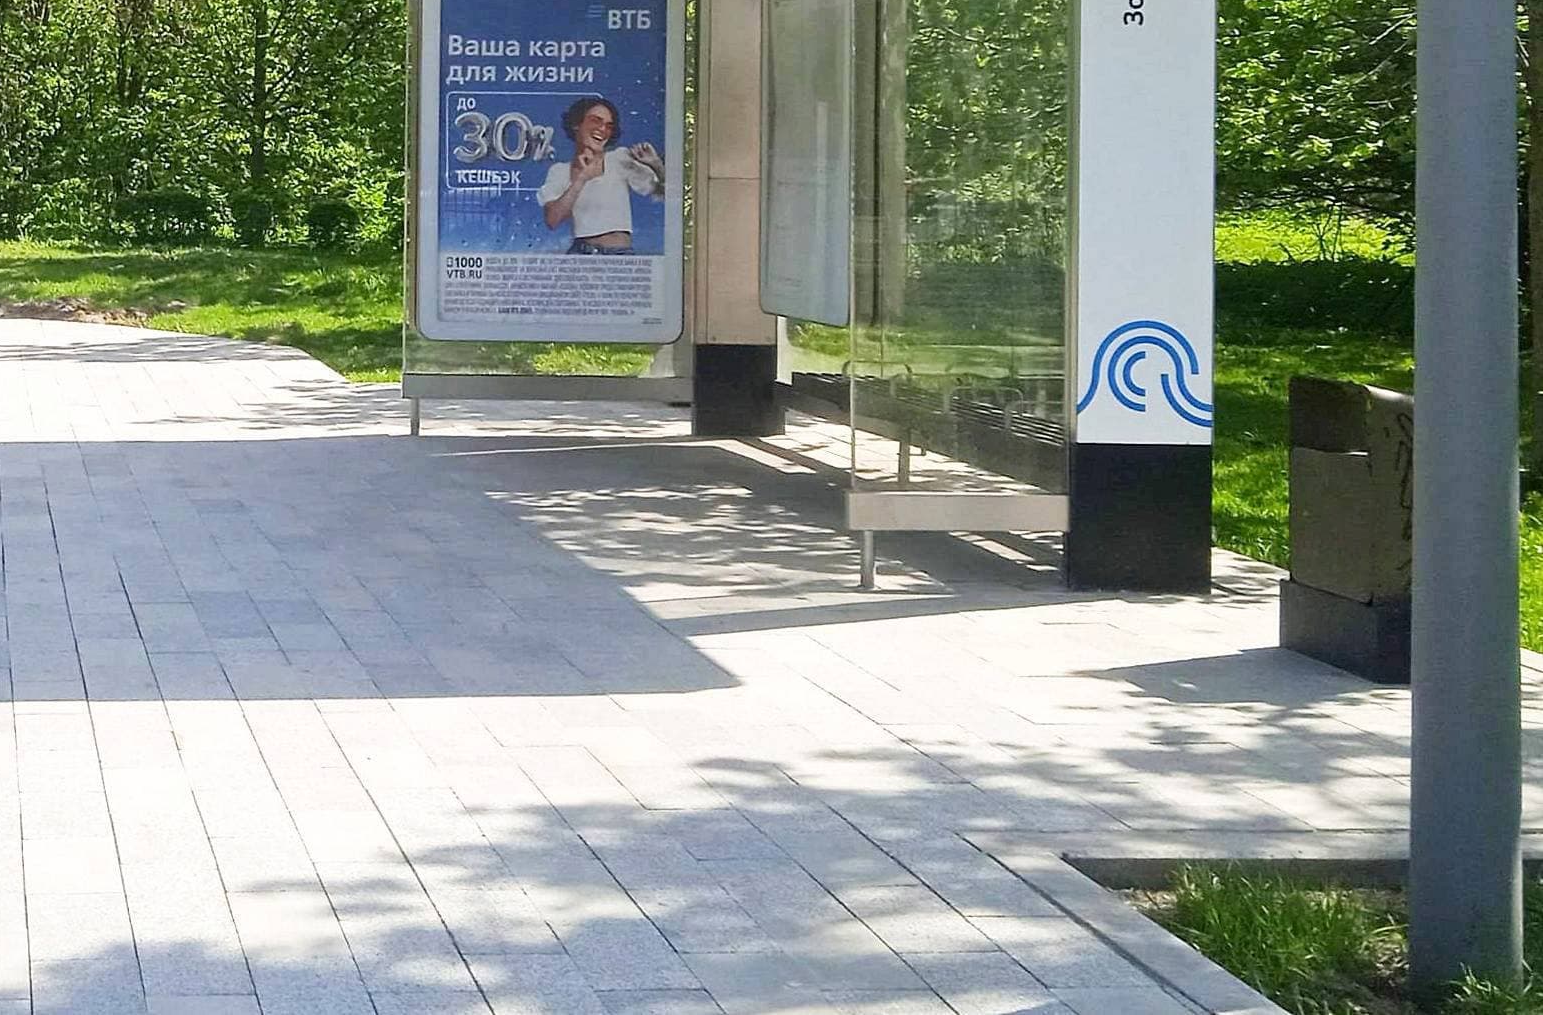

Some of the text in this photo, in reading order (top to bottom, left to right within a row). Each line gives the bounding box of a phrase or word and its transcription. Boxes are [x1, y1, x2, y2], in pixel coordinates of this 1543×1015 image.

[608, 9, 651, 30] ВТБ
[448, 34, 606, 62] Ваша карта
[445, 65, 594, 85] для жизни
[457, 170, 522, 184] КЕШБЭК
[447, 269, 483, 279] VTB.RU
